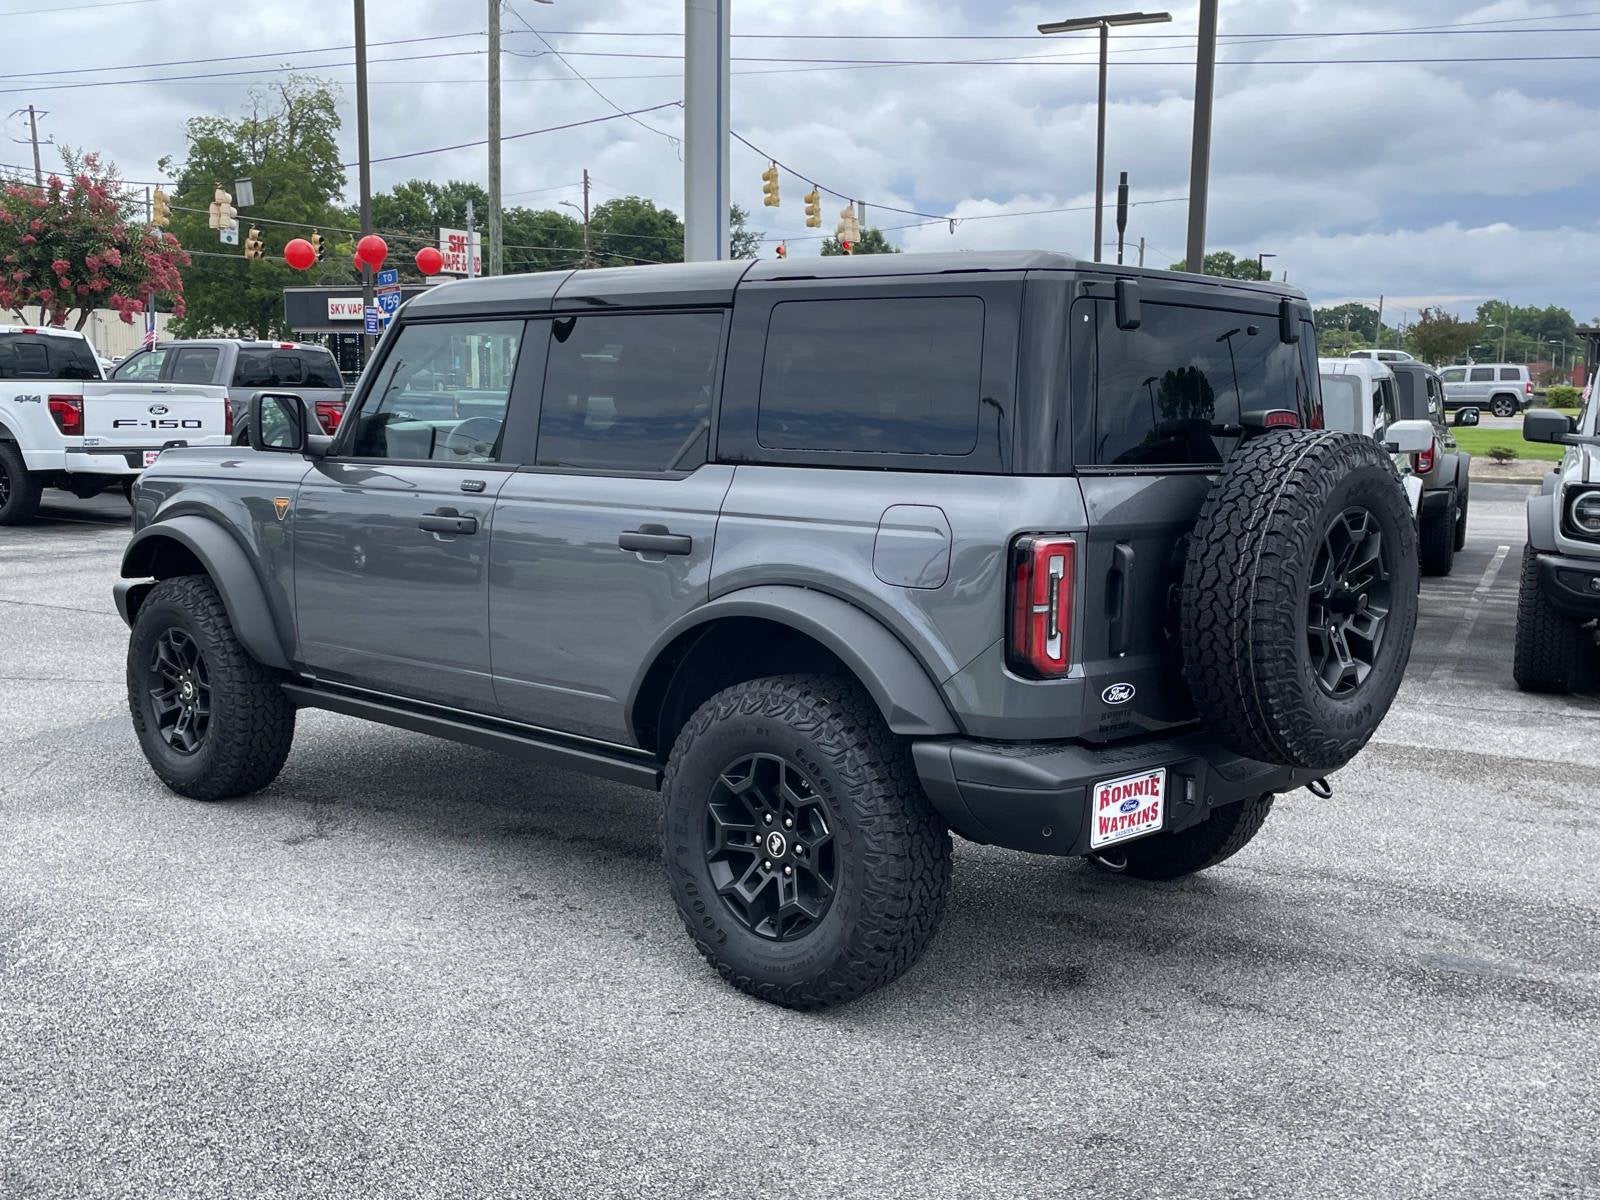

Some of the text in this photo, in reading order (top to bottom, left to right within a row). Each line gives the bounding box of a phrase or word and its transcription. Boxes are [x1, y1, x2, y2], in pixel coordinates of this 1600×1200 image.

[449, 234, 468, 253] SK
[382, 273, 393, 283] TO
[330, 303, 346, 315] SKY
[347, 303, 363, 315] VAP
[381, 294, 399, 310] 759
[113, 419, 202, 429] F-150
[1099, 776, 1161, 811] RONNIE
[1098, 801, 1159, 836] WATKINS
